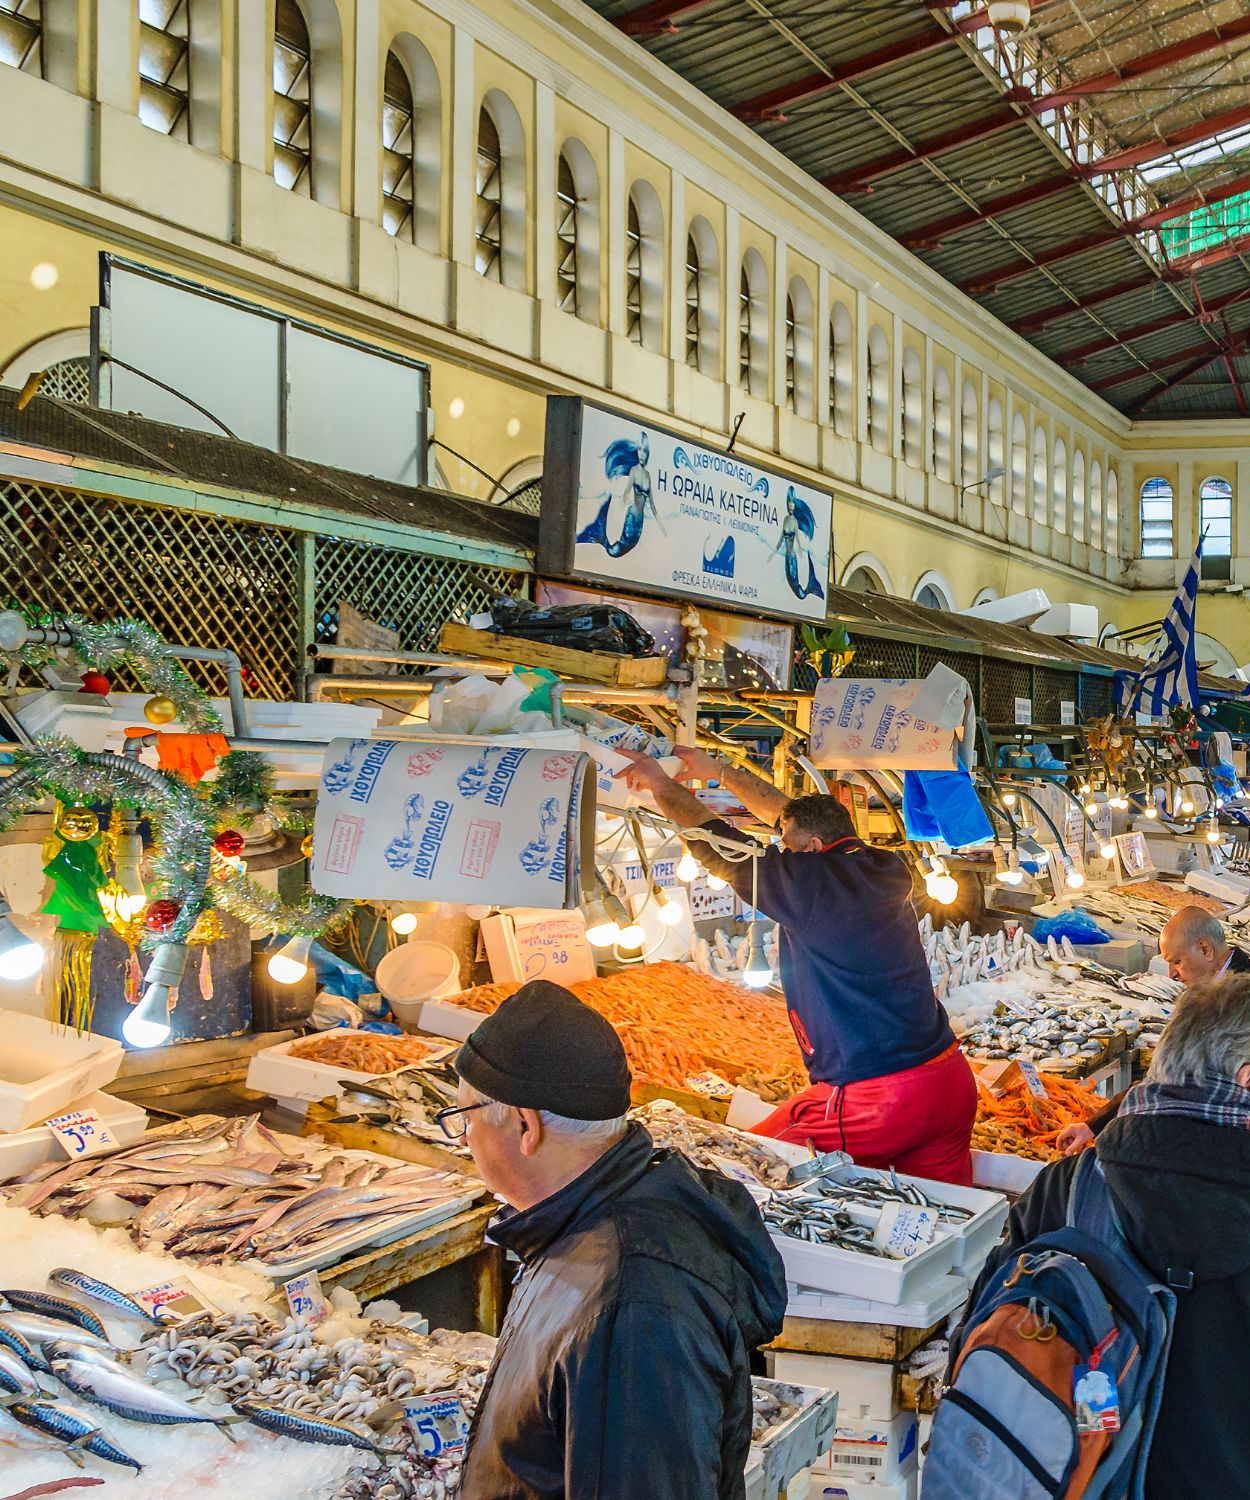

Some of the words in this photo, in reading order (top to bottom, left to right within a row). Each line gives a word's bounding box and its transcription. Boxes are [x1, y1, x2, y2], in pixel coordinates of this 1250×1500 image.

[693, 452, 753, 486] ΙΧΘΥΟΠΩΛΕΙΟ
[657, 469, 668, 492] Η
[672, 474, 715, 507] ΩΡΑΙΑ
[719, 489, 779, 526] ΚΑΤΕΡΙΝΑ
[671, 570, 700, 586] ΦΡΕΣΚΑ
[702, 576, 737, 595] ΕΛΛΗΝΙΚΑ
[738, 584, 759, 600] ΨΑΡΙΑ
[839, 683, 860, 729] ΙΧΘΥΟΠΩΛΕΙΟ
[873, 704, 897, 751] ΙΧΘΥΟΠΩΛΕΙΟ
[412, 799, 450, 879] ΙΧΘΥΟΠΩΛΕΙΟ
